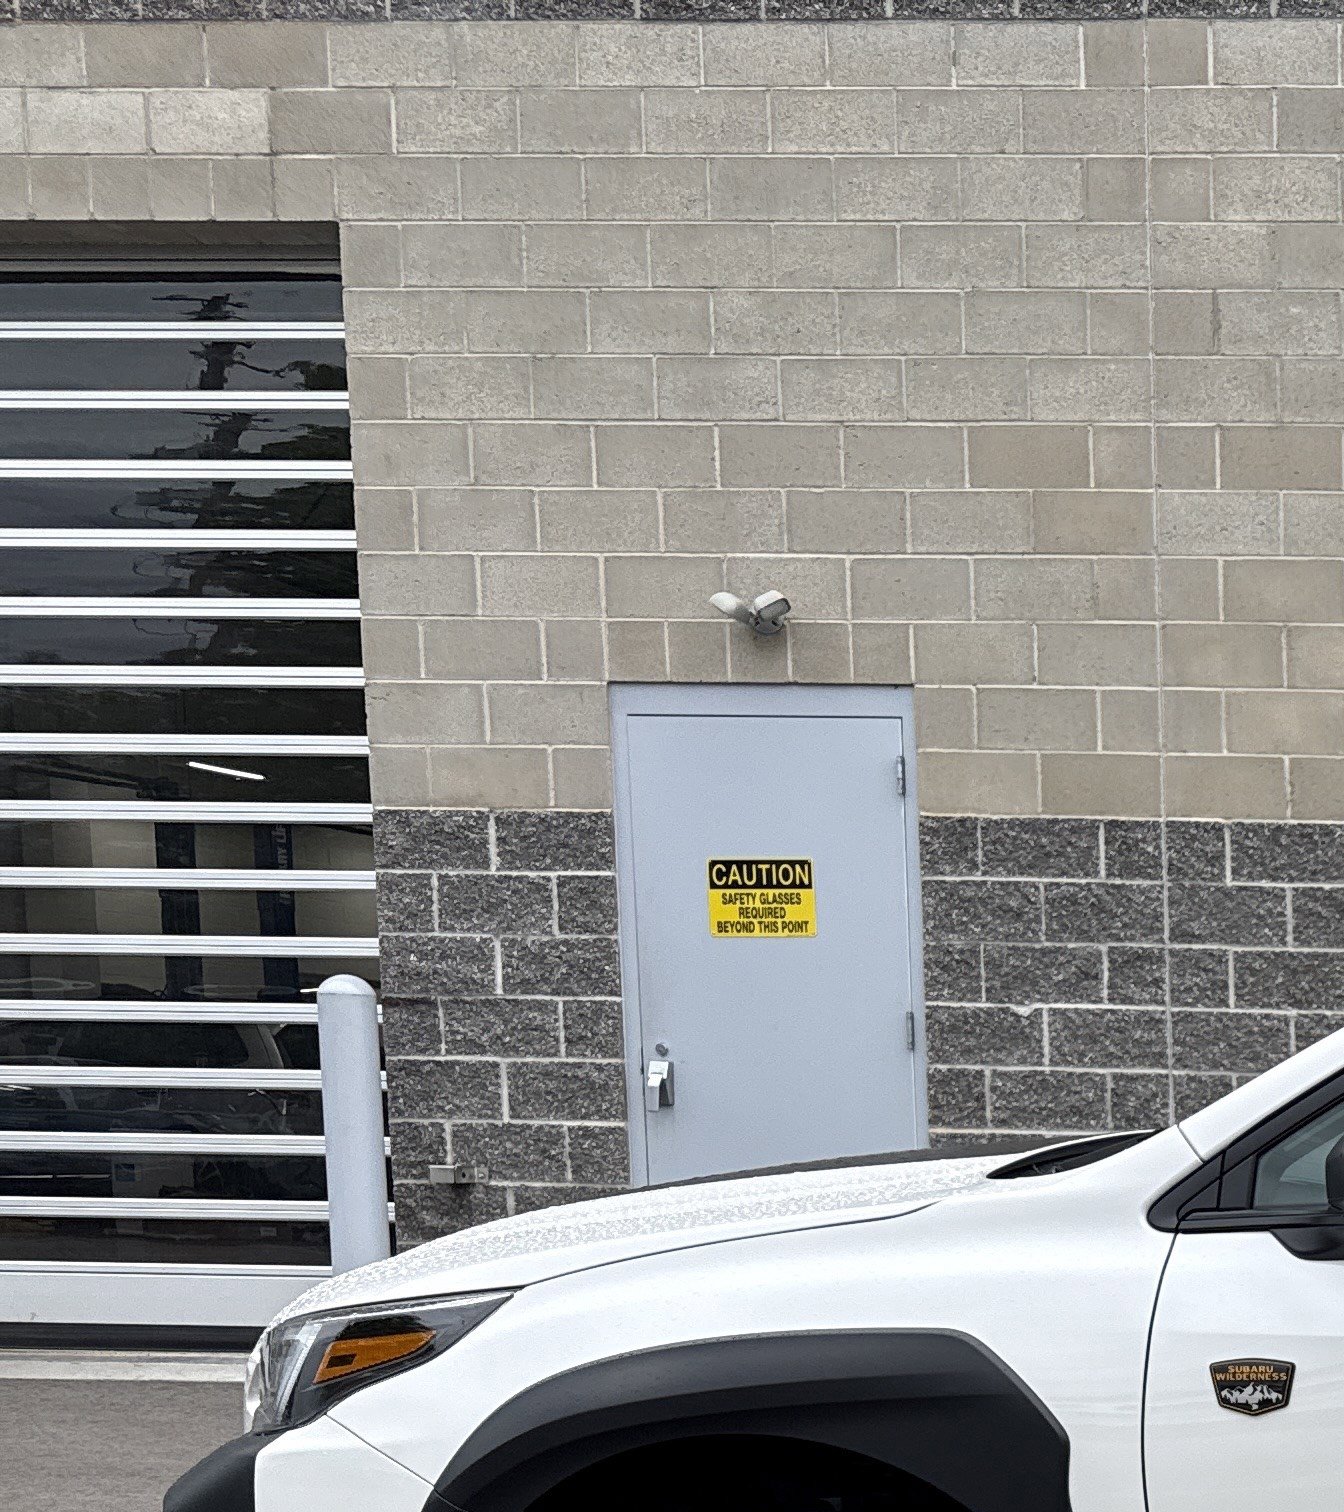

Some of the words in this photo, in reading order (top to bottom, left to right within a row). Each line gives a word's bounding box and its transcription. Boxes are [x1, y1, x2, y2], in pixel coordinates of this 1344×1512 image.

[711, 863, 810, 886] CAUTION
[721, 892, 757, 906] SAFETY
[758, 892, 802, 906] GLASSES
[738, 906, 787, 920] REQUIRED
[716, 920, 756, 934] BEYOND
[757, 920, 779, 934] THIS
[781, 920, 810, 934] POINT
[1227, 1365, 1274, 1373] SUBARU
[1215, 1372, 1288, 1381] WILDERNESS
